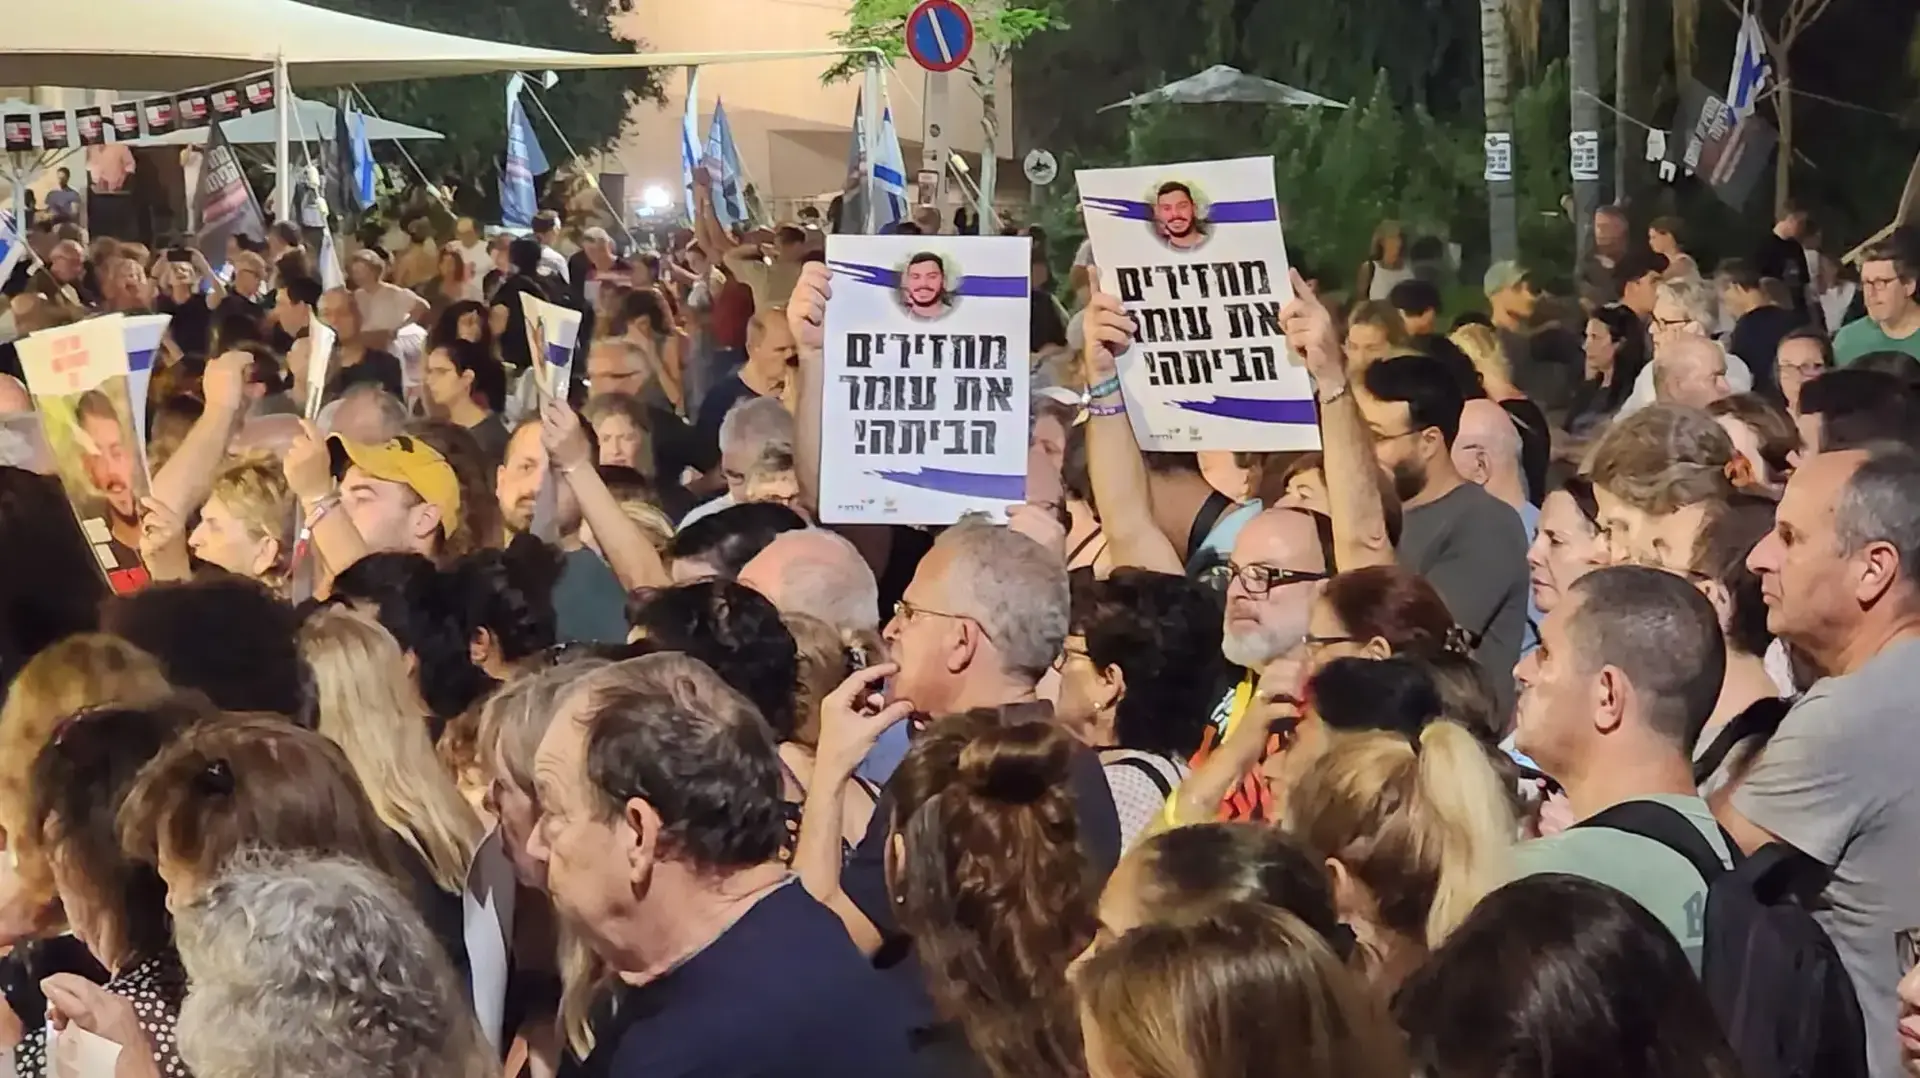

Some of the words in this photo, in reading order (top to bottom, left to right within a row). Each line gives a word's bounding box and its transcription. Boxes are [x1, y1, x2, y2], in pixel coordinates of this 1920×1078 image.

[1116, 260, 1271, 302] מחזירים
[1224, 302, 1287, 338] את
[846, 333, 1007, 370] מחזירים
[1144, 346, 1278, 386] הביתה!
[839, 375, 937, 411] עומר
[953, 376, 1013, 411] את
[855, 419, 997, 455] הביתה!
